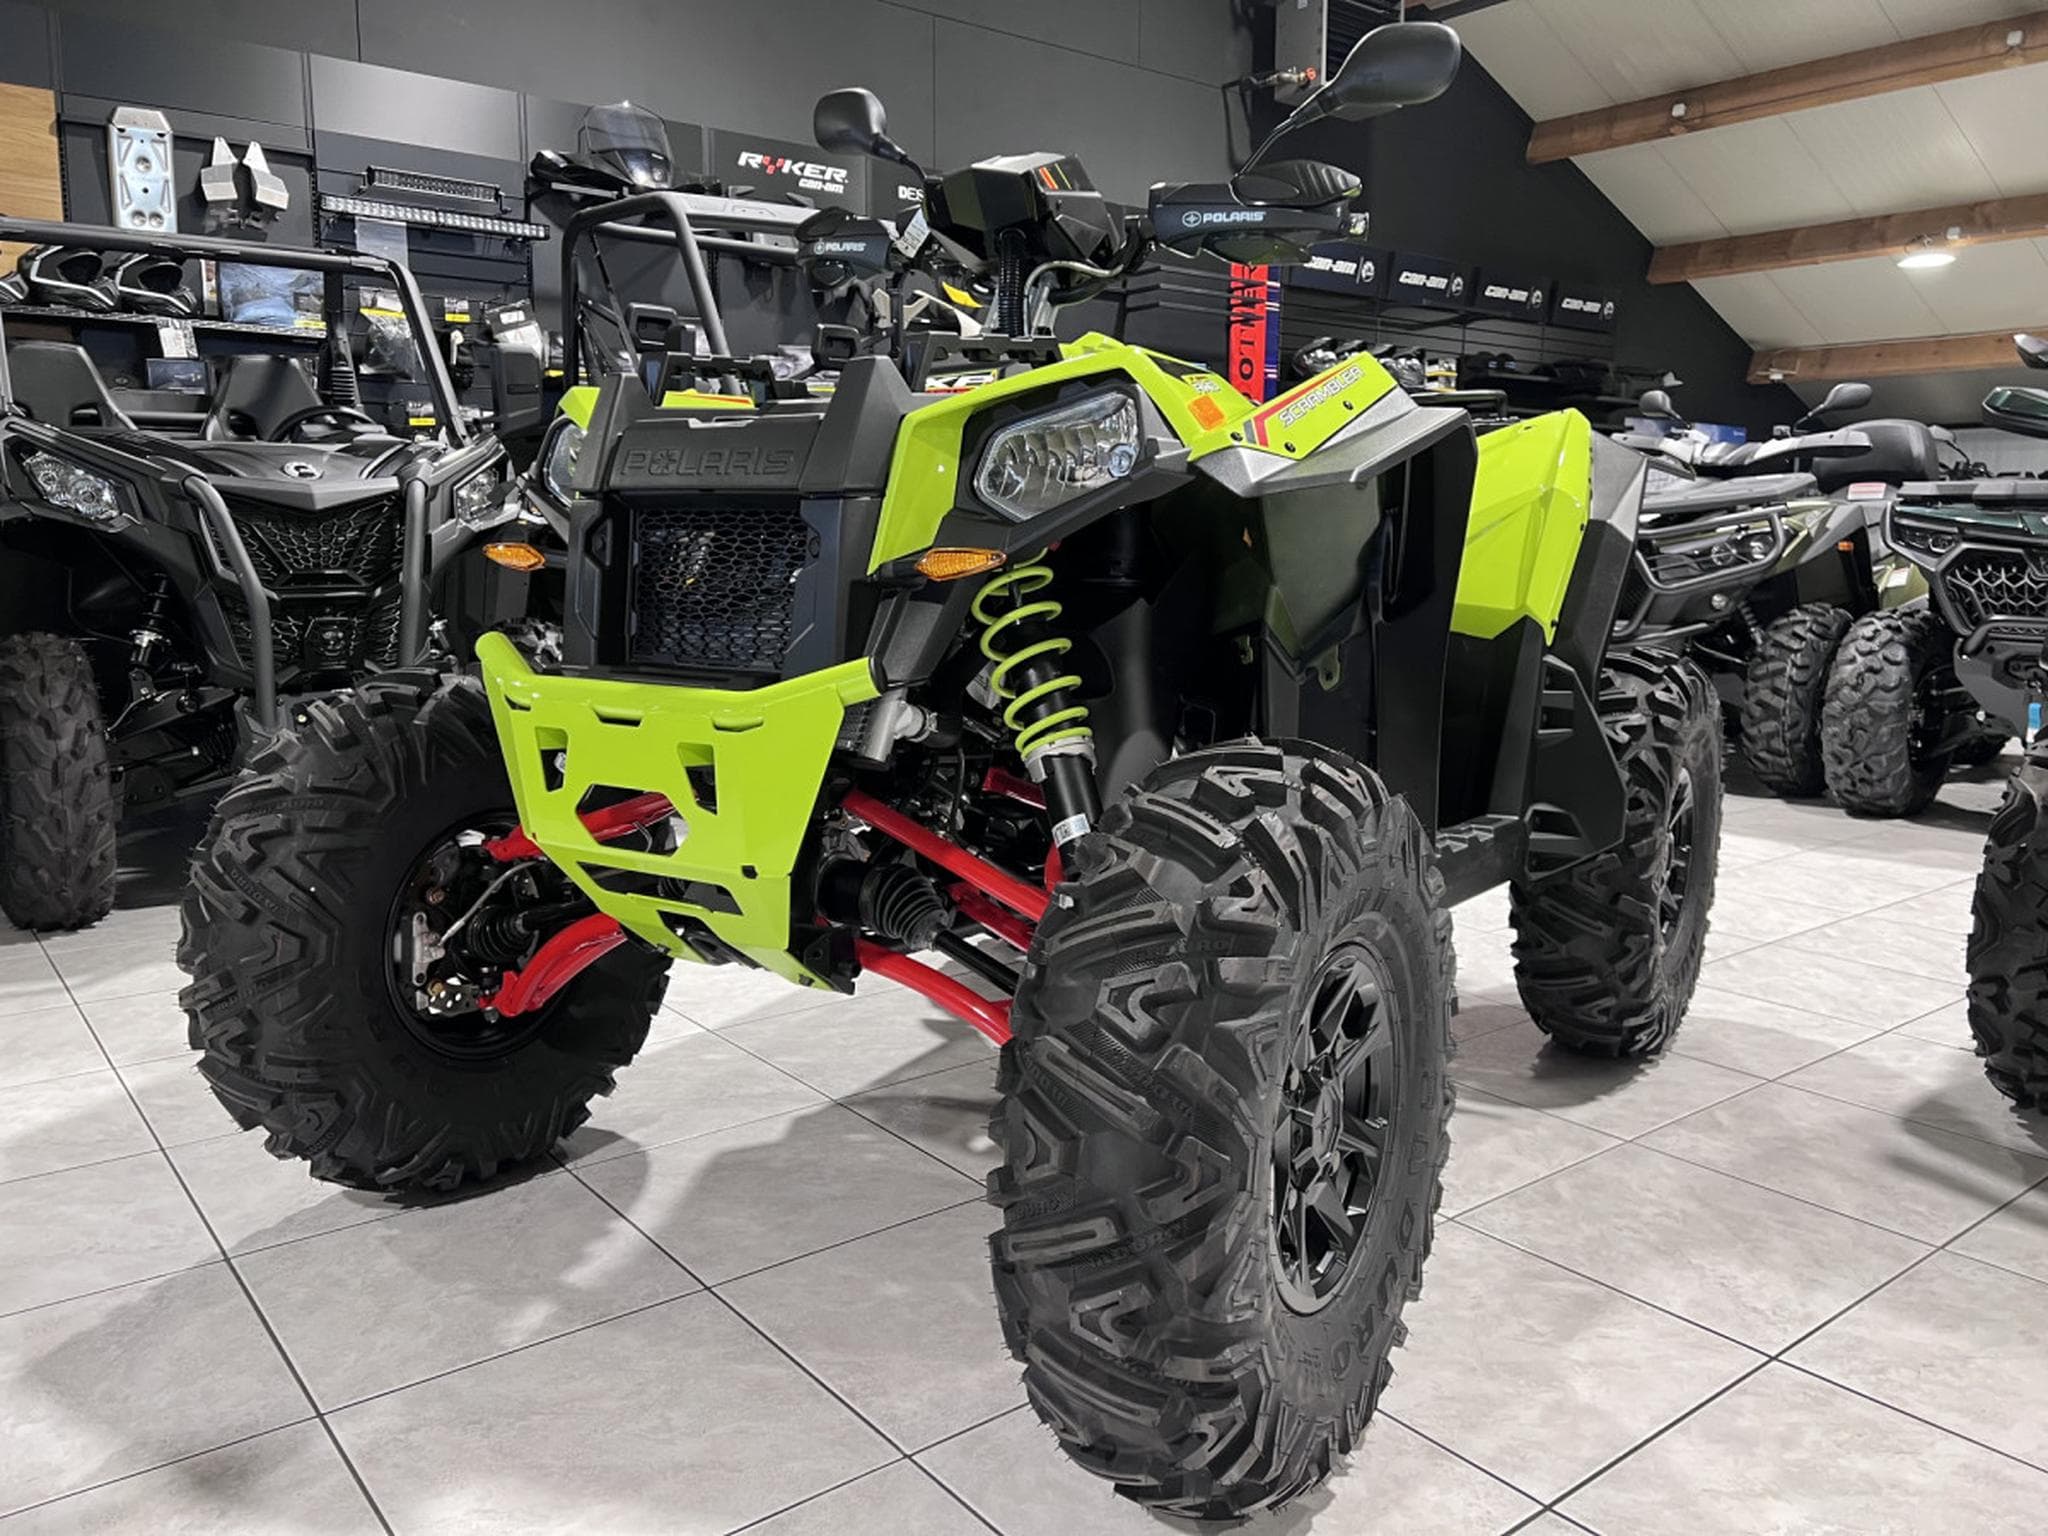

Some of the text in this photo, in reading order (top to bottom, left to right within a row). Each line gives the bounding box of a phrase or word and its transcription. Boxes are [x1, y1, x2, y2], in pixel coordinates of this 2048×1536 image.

[738, 151, 847, 183] RYKER
[1202, 210, 1265, 224] POLARIS
[825, 241, 867, 252] POLARIS
[1279, 365, 1363, 427] SCRAMBLER
[620, 449, 794, 476] POLARIS
